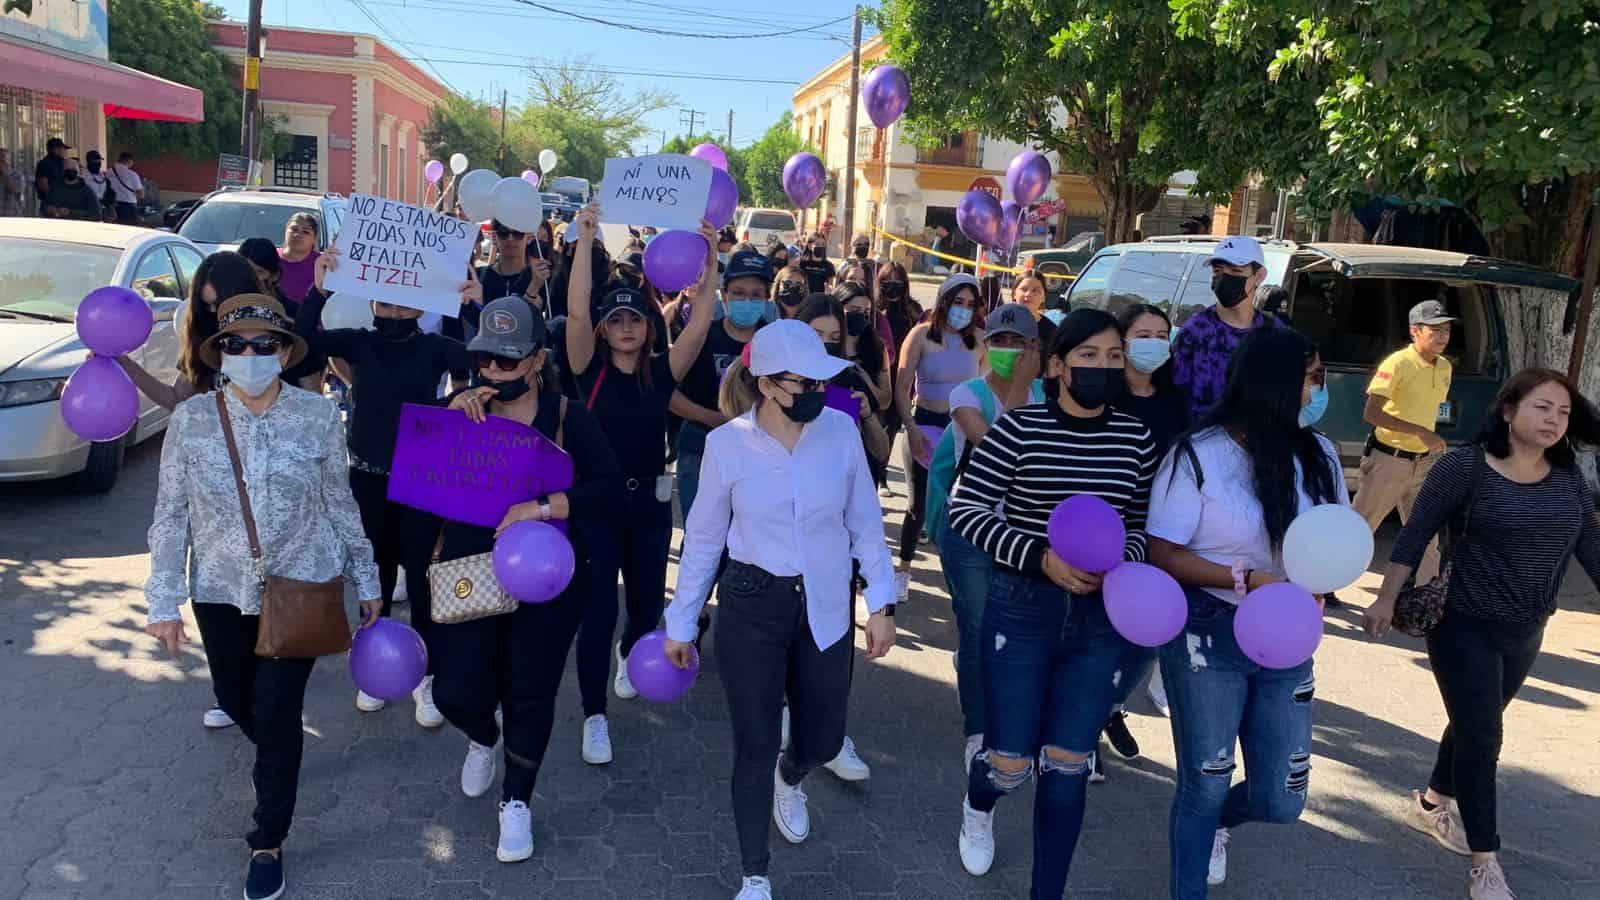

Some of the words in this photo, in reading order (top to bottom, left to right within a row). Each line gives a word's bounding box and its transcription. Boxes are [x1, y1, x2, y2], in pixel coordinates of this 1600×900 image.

[657, 165, 692, 181] UNA
[351, 197, 376, 217] NO
[381, 202, 467, 239] ESTAMOS
[356, 217, 413, 245] TODAS
[413, 230, 448, 254] NOS
[367, 246, 426, 270] FALTA
[357, 263, 423, 288] ITZEL
